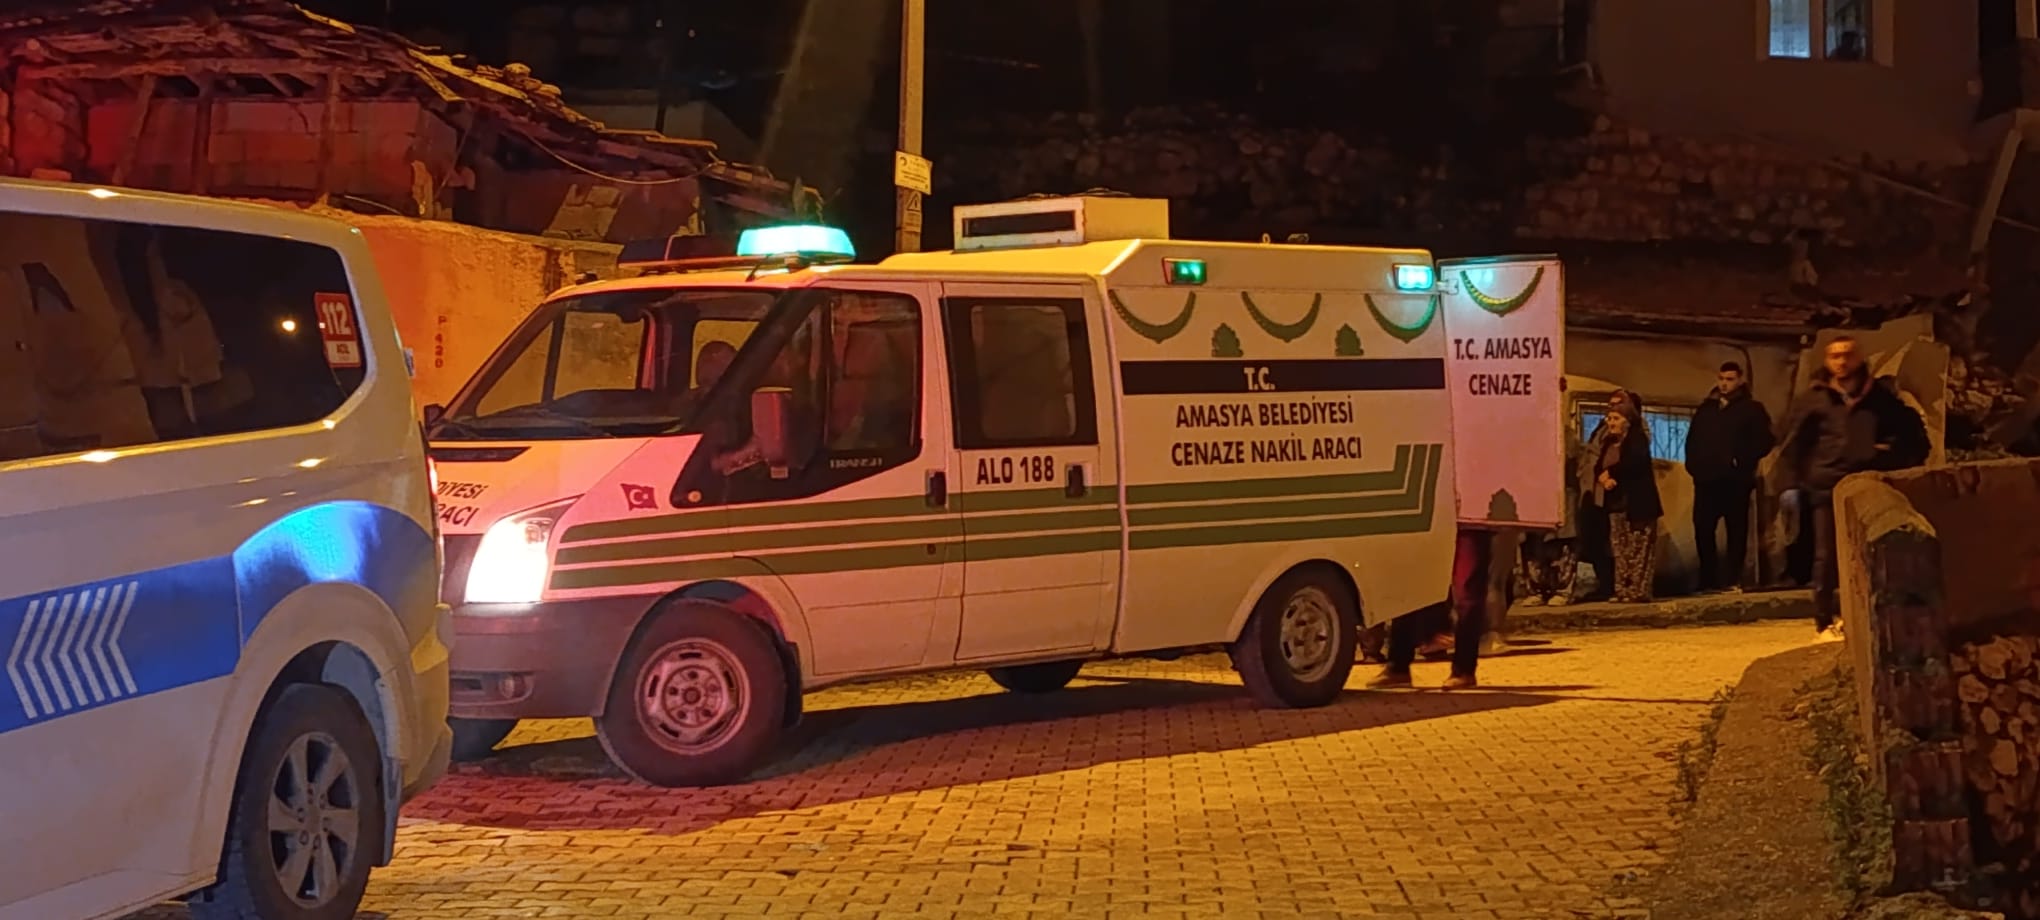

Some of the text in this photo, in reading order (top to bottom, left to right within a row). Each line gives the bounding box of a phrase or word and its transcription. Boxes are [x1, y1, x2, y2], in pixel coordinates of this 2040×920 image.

[321, 302, 352, 334] 112
[1453, 337, 1553, 360] T.C. AMASYA
[1243, 366, 1276, 391] T.C.
[1468, 374, 1531, 396] CENAZE
[1175, 395, 1354, 428] AMASYA BELEDİYESİ
[1171, 432, 1363, 466] CENAZE NAKİL ARACI
[976, 455, 1055, 485] ALO 188
